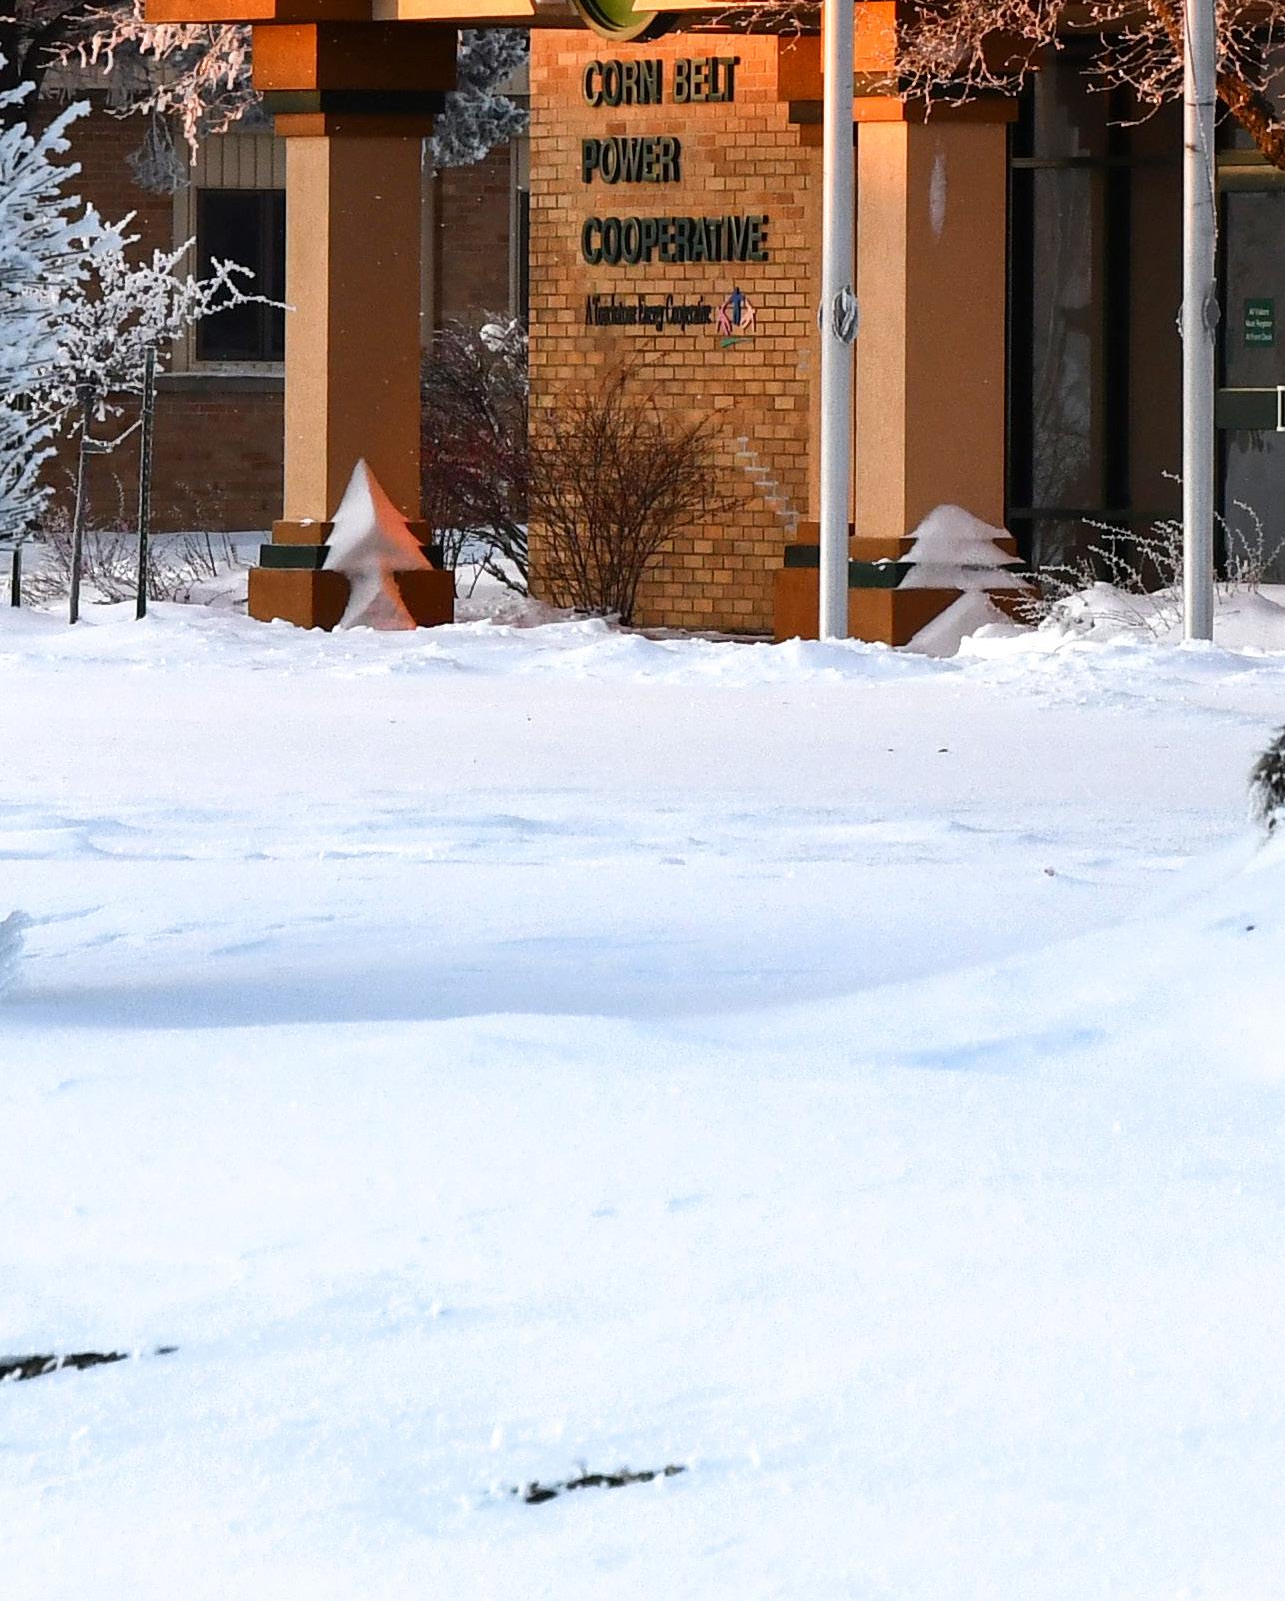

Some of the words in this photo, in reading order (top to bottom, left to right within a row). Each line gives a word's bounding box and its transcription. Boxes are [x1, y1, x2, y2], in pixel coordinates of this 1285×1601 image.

[583, 59, 663, 106] CORN
[673, 56, 740, 103] BELT
[581, 136, 682, 184] POWER
[581, 214, 769, 265] COOPERATIVE
